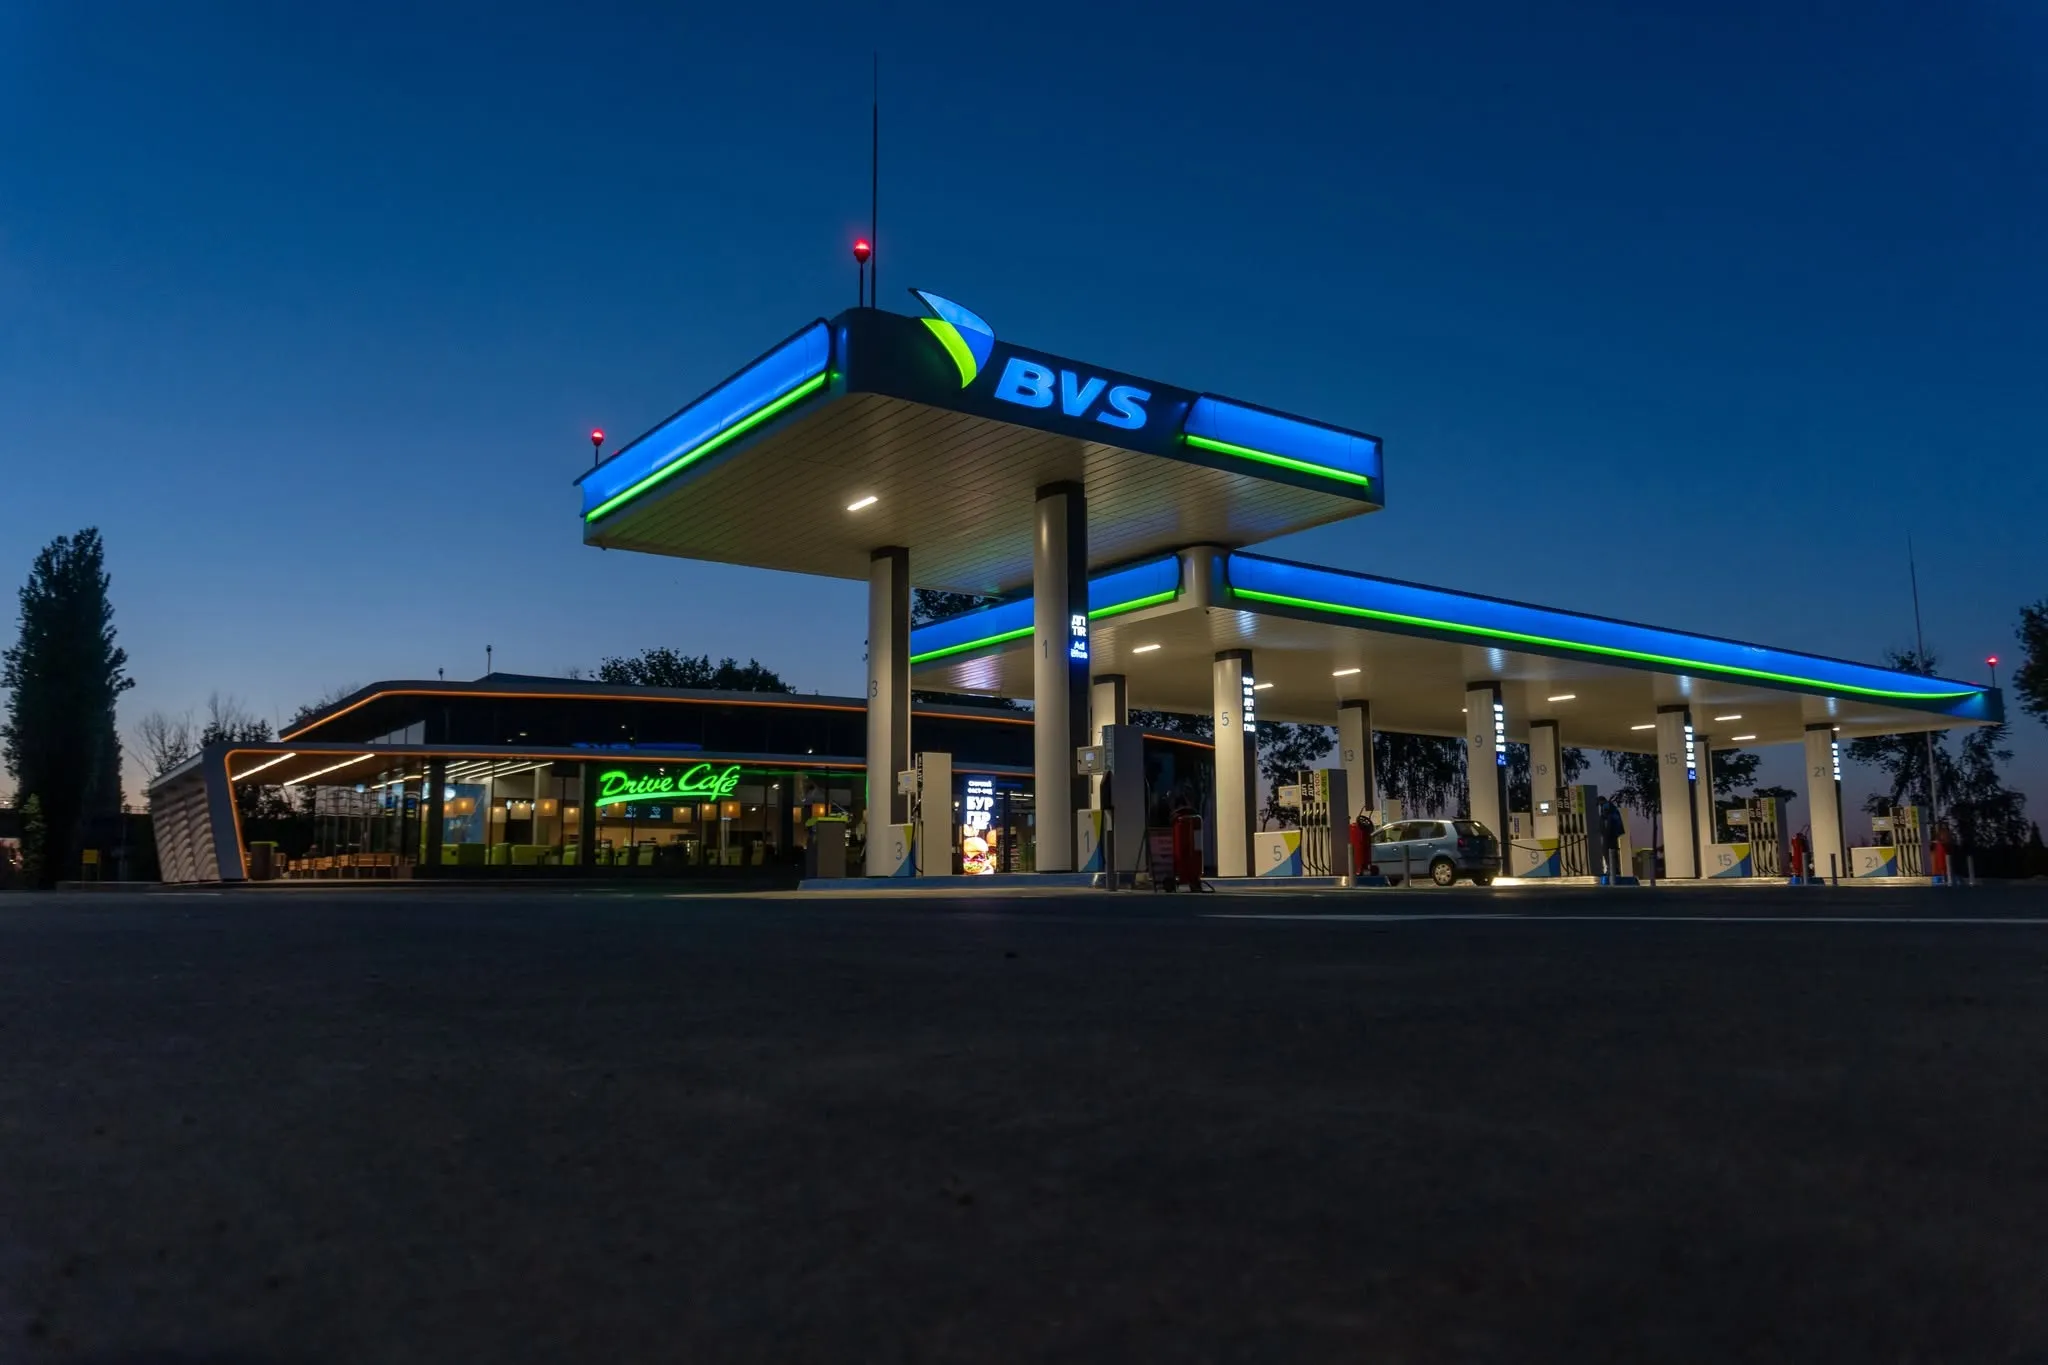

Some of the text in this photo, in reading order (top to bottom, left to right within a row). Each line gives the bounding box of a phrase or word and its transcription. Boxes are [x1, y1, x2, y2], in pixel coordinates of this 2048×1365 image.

[994, 357, 1152, 430] BVS
[1042, 639, 1048, 659] 1
[871, 680, 878, 698] 3
[1221, 711, 1230, 726] 5
[1475, 735, 1483, 748] 9
[1344, 749, 1354, 762] 13
[1664, 752, 1678, 765] 15
[1536, 764, 1547, 775] 19
[1813, 767, 1826, 777] 21
[600, 763, 741, 801] Drive Café
[1083, 830, 1090, 854] 1
[895, 841, 903, 861] 3
[1273, 845, 1282, 862] 5
[1530, 850, 1539, 865] 9
[1718, 853, 1732, 866] 15
[1865, 856, 1878, 869] 21
